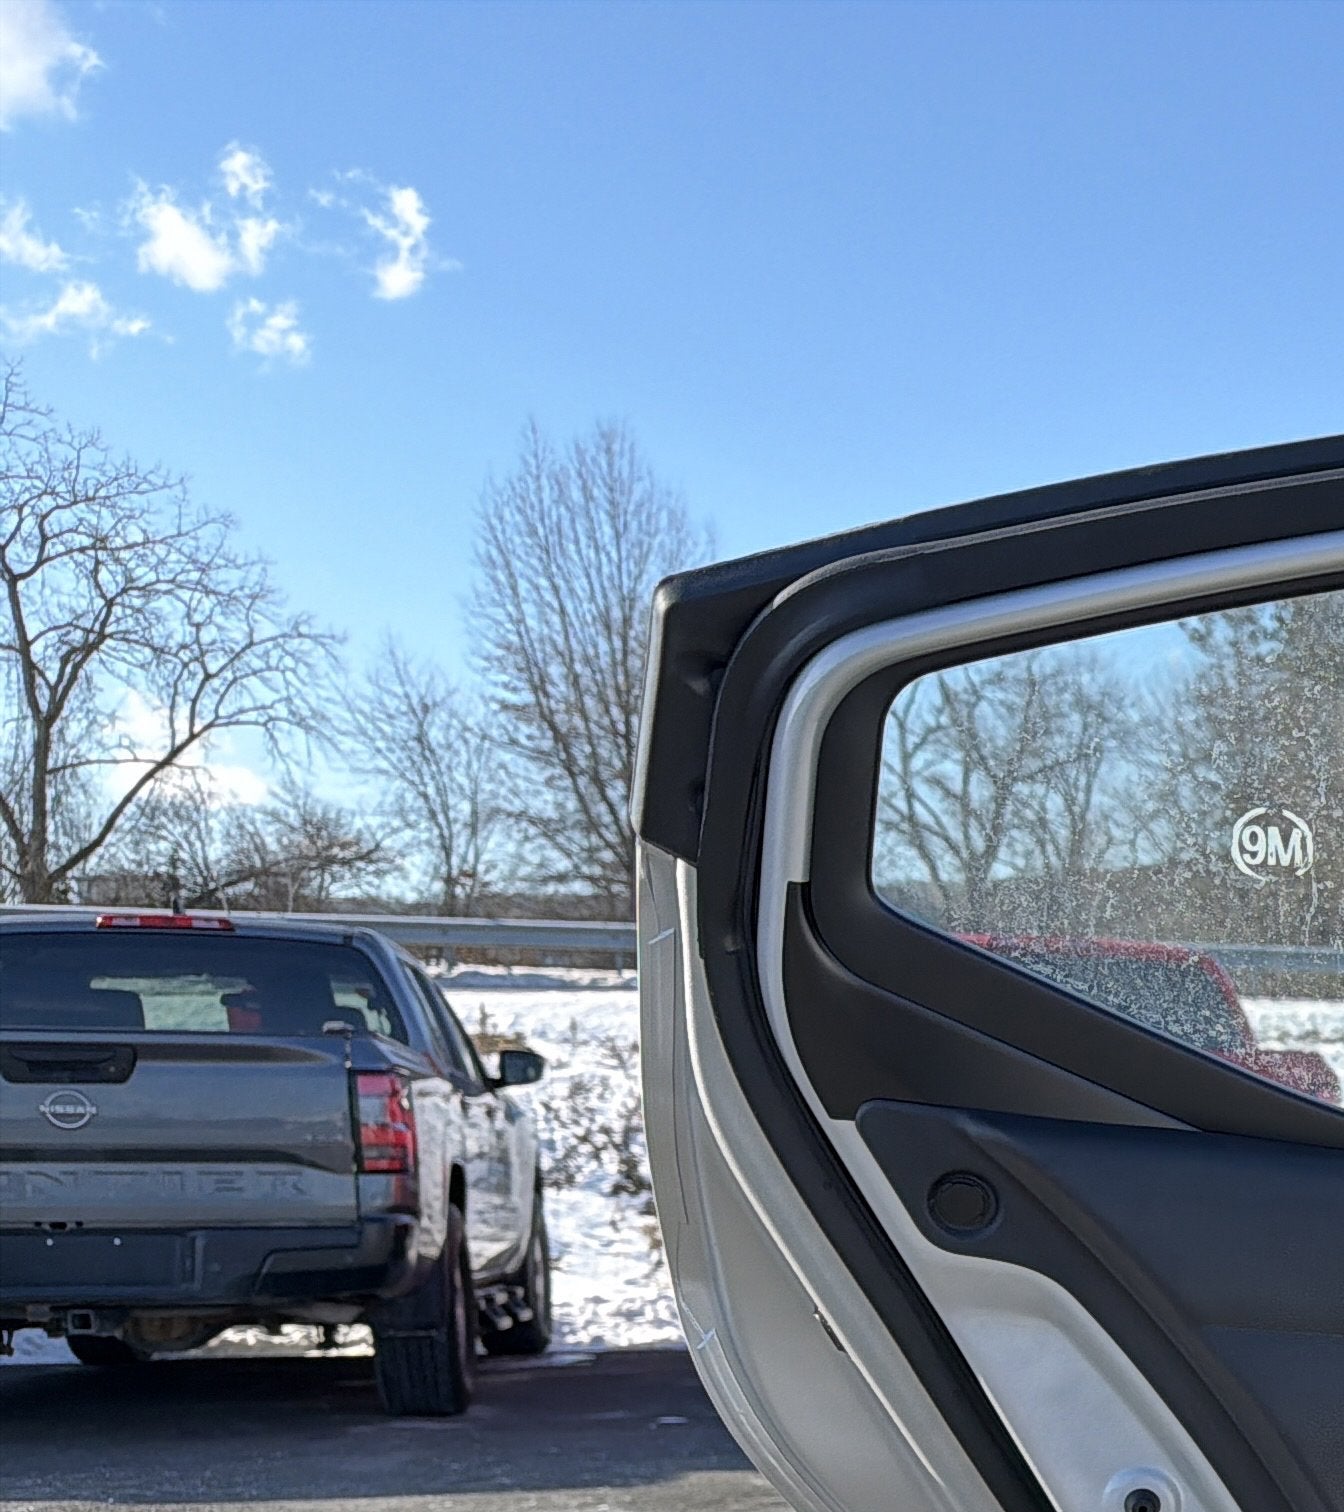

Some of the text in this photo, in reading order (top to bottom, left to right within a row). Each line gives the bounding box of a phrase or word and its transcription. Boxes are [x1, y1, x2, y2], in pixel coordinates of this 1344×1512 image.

[1241, 825, 1303, 868] 9M
[39, 1103, 98, 1115] NISSAN
[0, 1170, 307, 1199] NTIER
